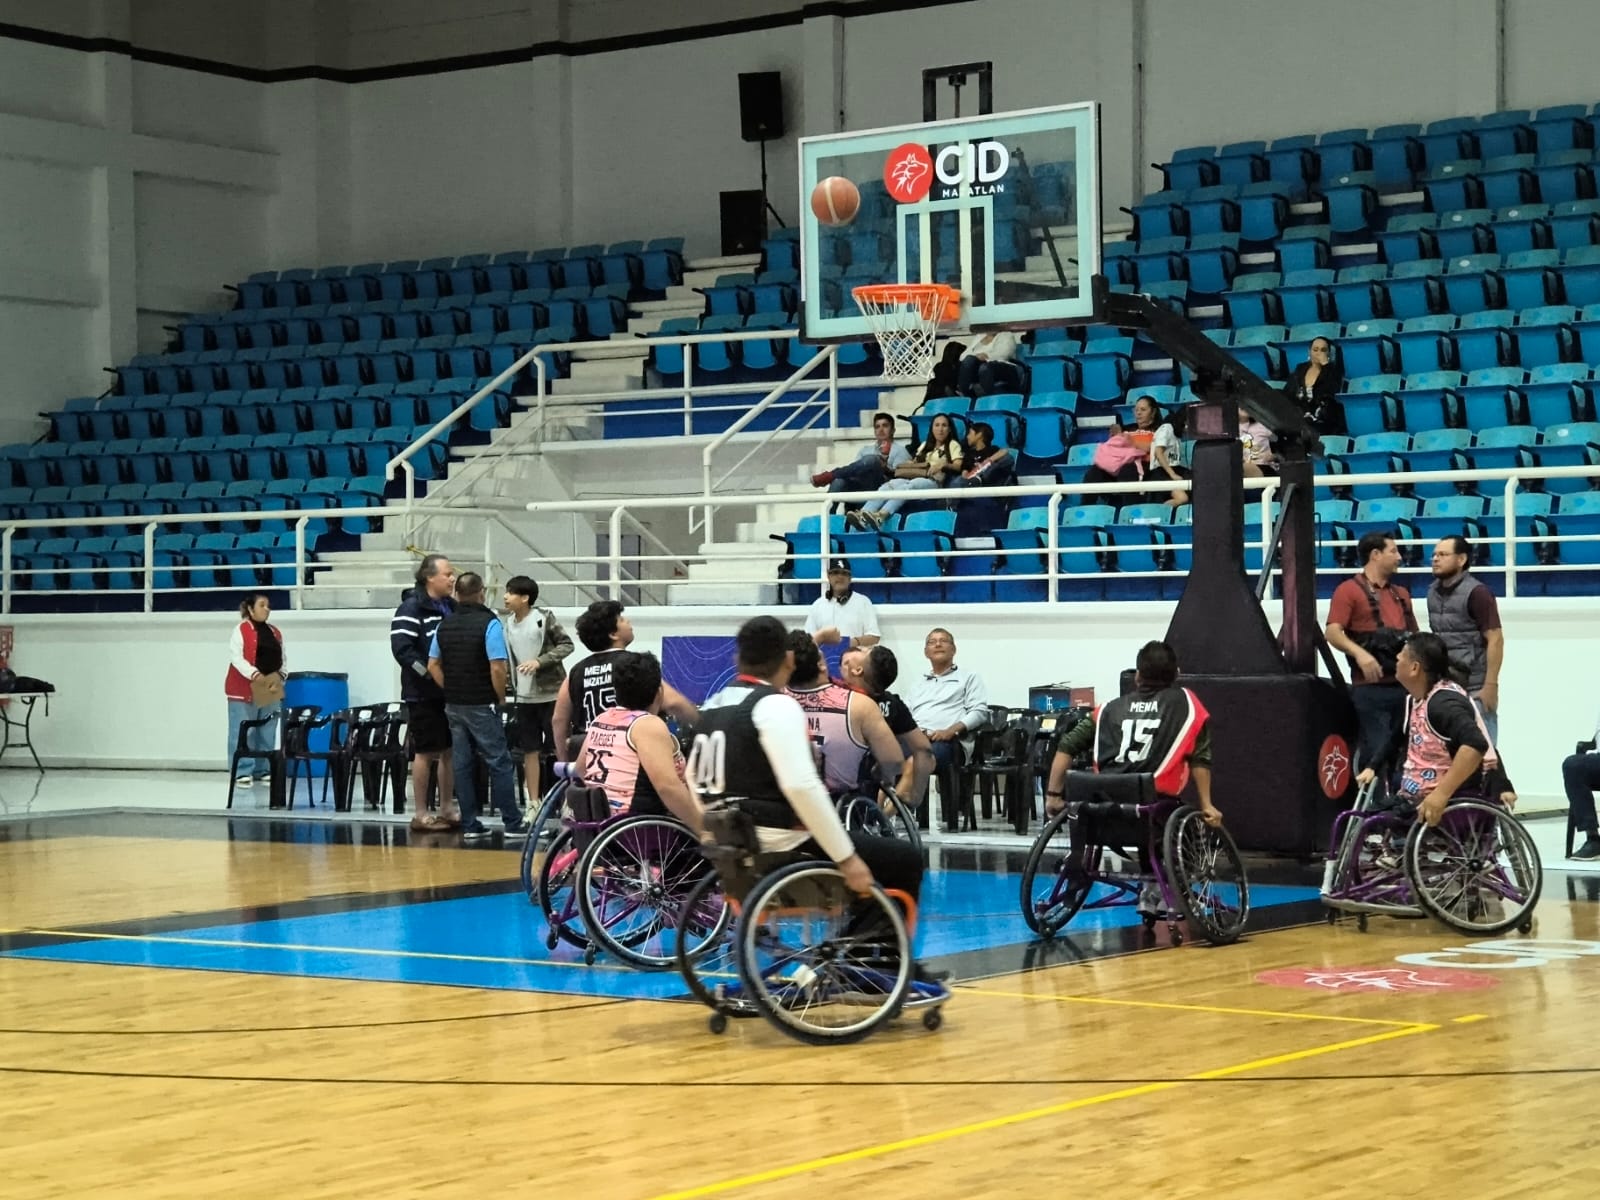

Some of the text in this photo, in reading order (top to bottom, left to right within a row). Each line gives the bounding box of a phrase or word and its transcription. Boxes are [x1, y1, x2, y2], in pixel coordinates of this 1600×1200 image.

[935, 141, 1010, 186] CID
[584, 663, 612, 676] MENA
[1129, 701, 1159, 713] MENA
[808, 717, 821, 731] NA
[1114, 718, 1161, 763] 15
[584, 747, 613, 784] 25
